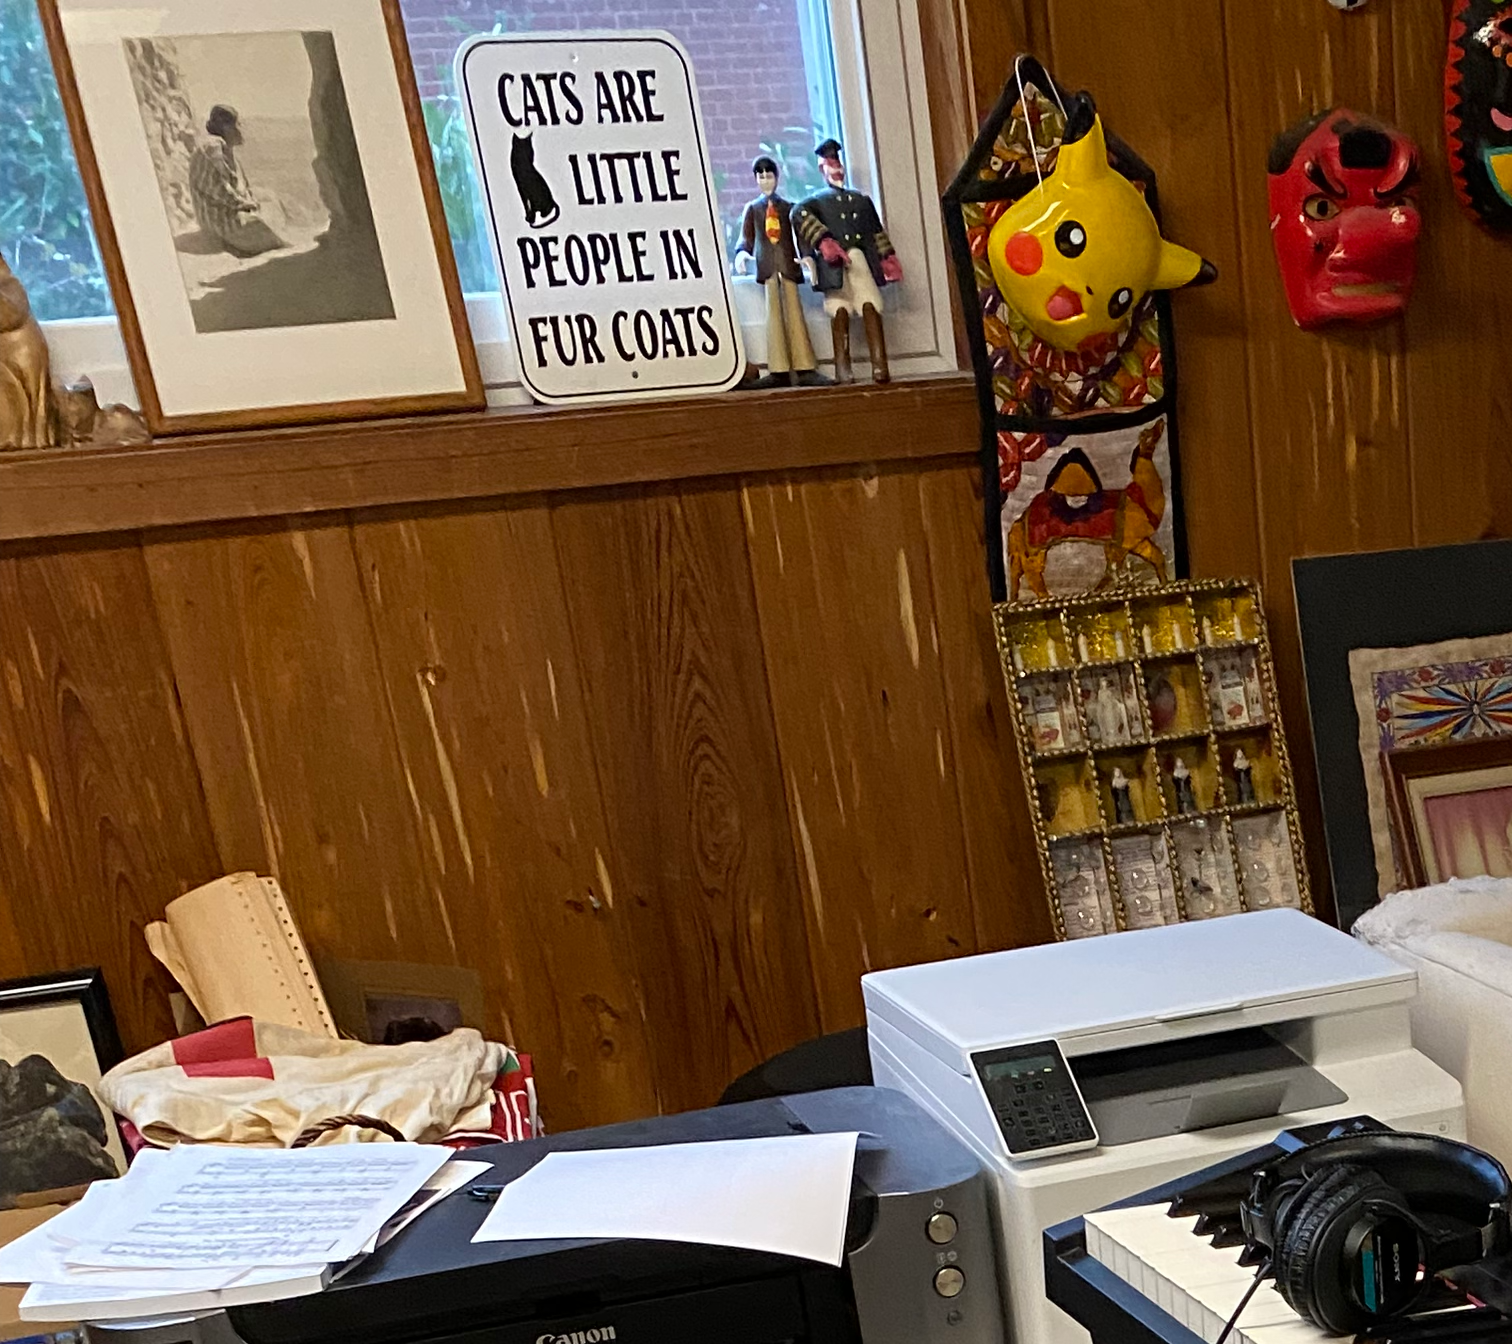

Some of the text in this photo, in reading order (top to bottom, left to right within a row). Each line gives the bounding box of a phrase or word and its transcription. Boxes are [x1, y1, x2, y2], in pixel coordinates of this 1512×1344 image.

[497, 70, 665, 127] CATS ARE
[568, 150, 688, 206] LITTLE
[516, 228, 703, 290] PEOPLE IN
[528, 305, 720, 369] FUR COATS
